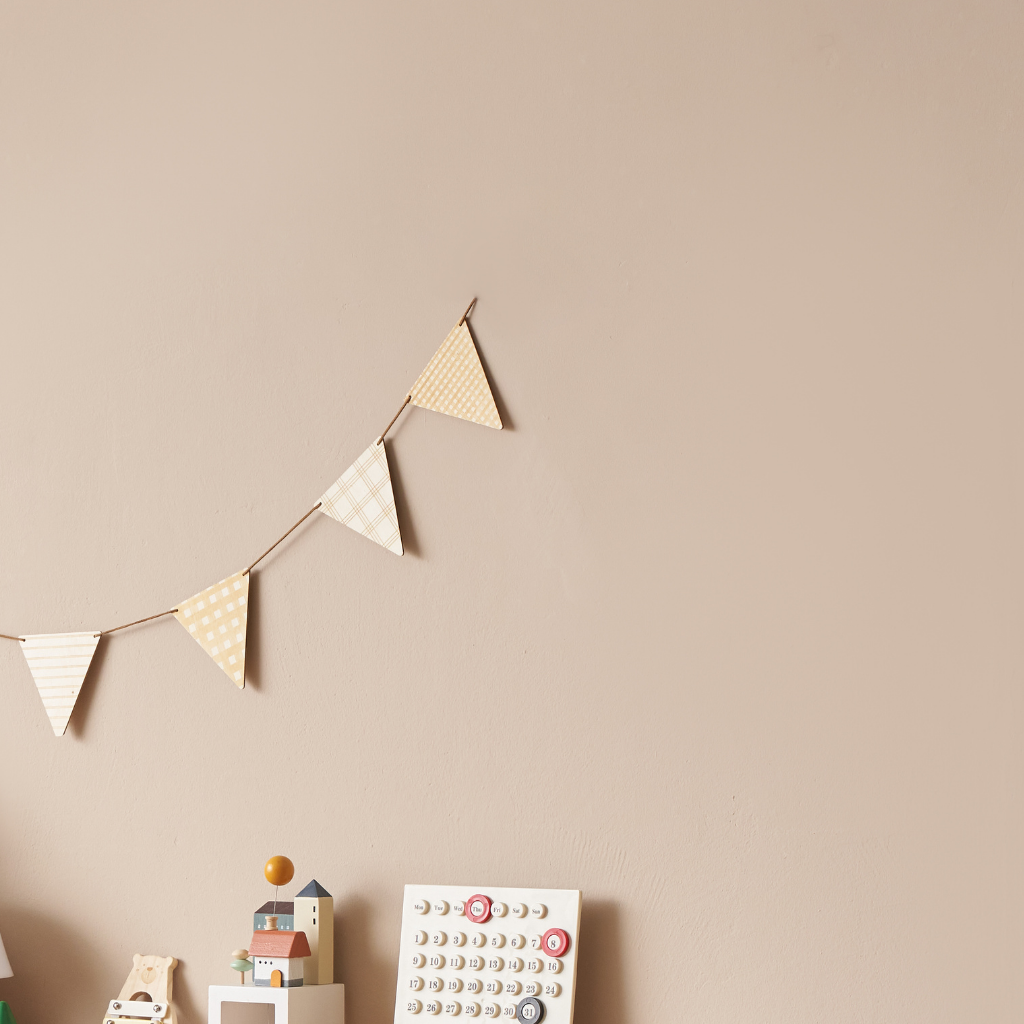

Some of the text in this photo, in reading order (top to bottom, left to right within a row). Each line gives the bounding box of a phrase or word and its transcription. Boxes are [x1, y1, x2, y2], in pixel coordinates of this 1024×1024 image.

[415, 935, 556, 948] 1 2 3 4 5 6 7 8
[412, 957, 557, 971] 9 10 11 12 13 14 15 16
[410, 980, 555, 995] 17 18 19 20 21 22 23 24
[408, 1003, 534, 1017] 25 26 27 28 29 30 31
